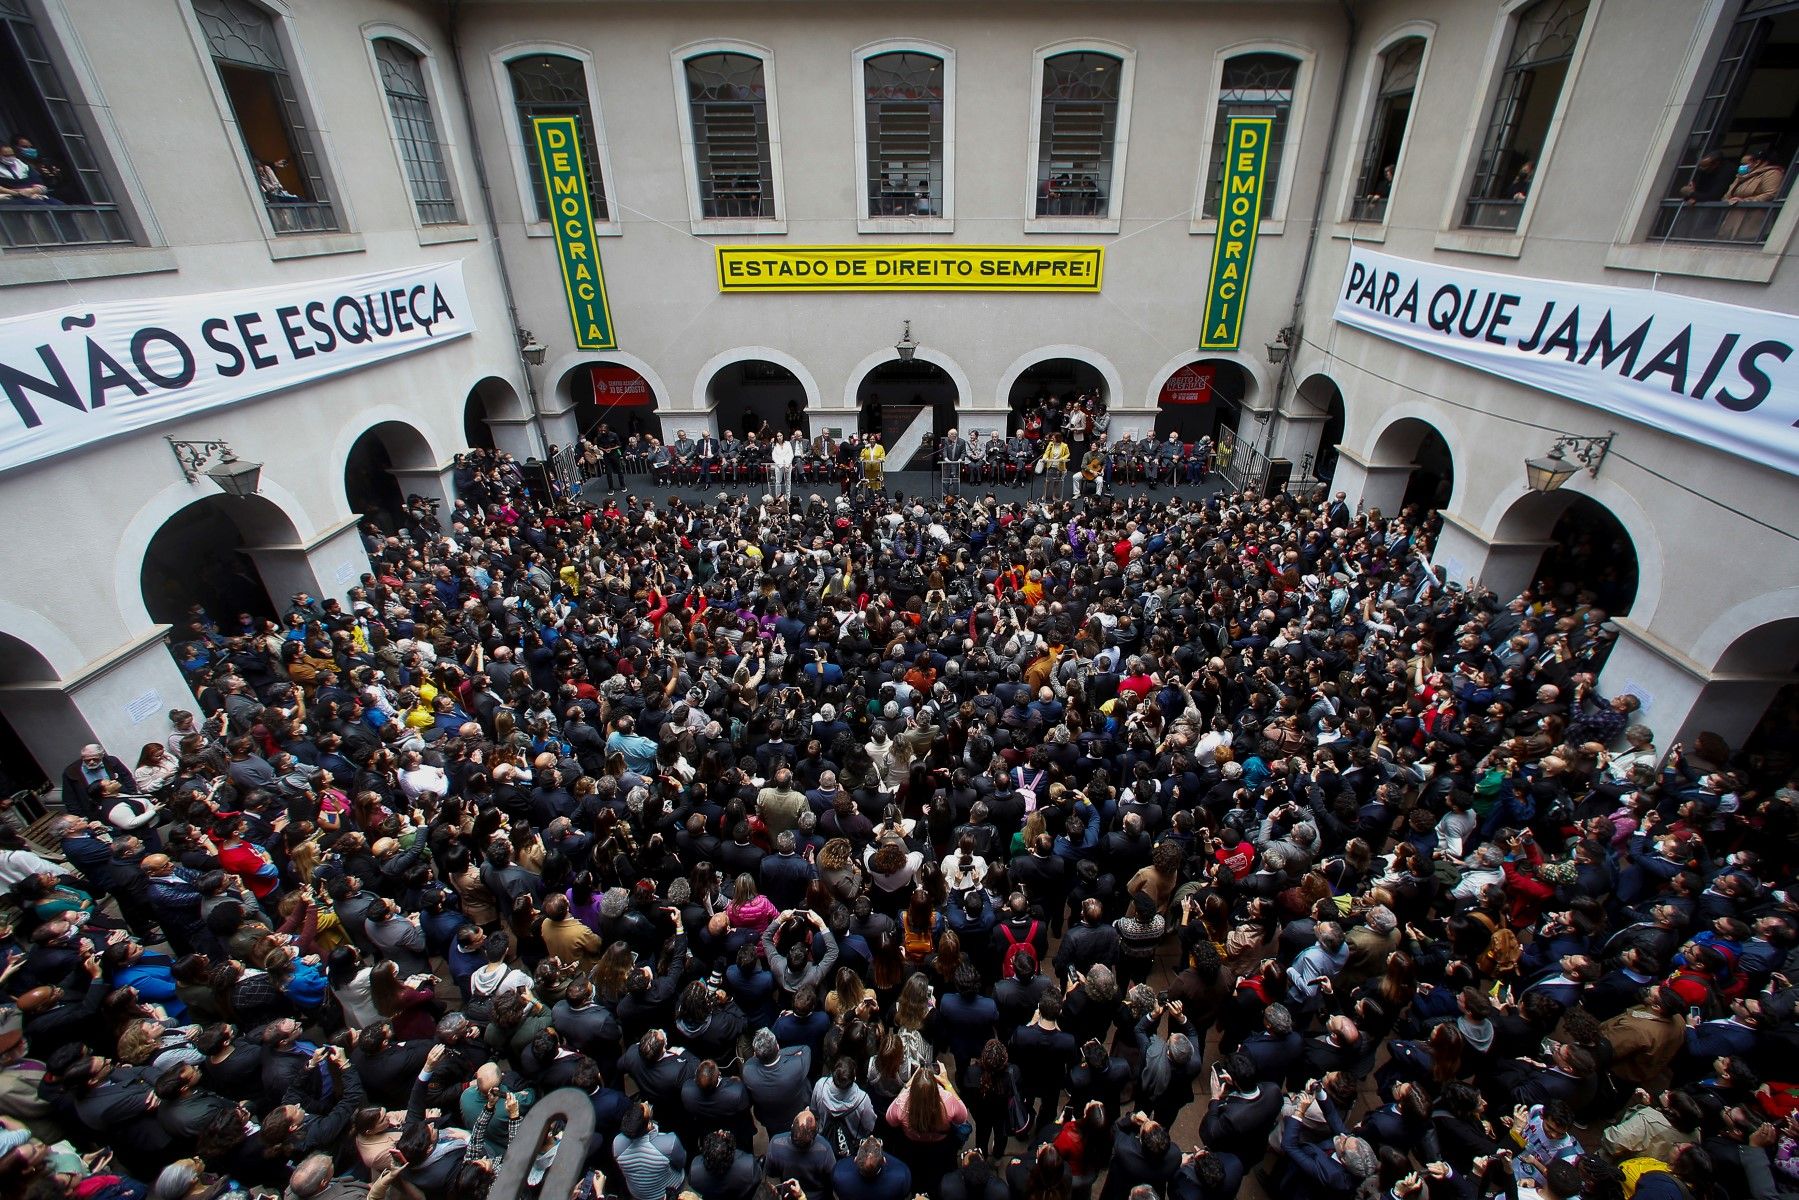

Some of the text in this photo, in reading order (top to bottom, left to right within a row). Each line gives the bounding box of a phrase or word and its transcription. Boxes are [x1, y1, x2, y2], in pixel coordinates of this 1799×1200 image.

[547, 129, 602, 340] DEMOCRACIA
[729, 259, 1091, 277] ESTADO DE DIREITO SEMPRE!
[1213, 129, 1258, 339] DEMOCRACIA
[0, 283, 455, 428] NÃO SE ESQUEÇA
[1345, 262, 1794, 412] PARA QUE JAMAIS
